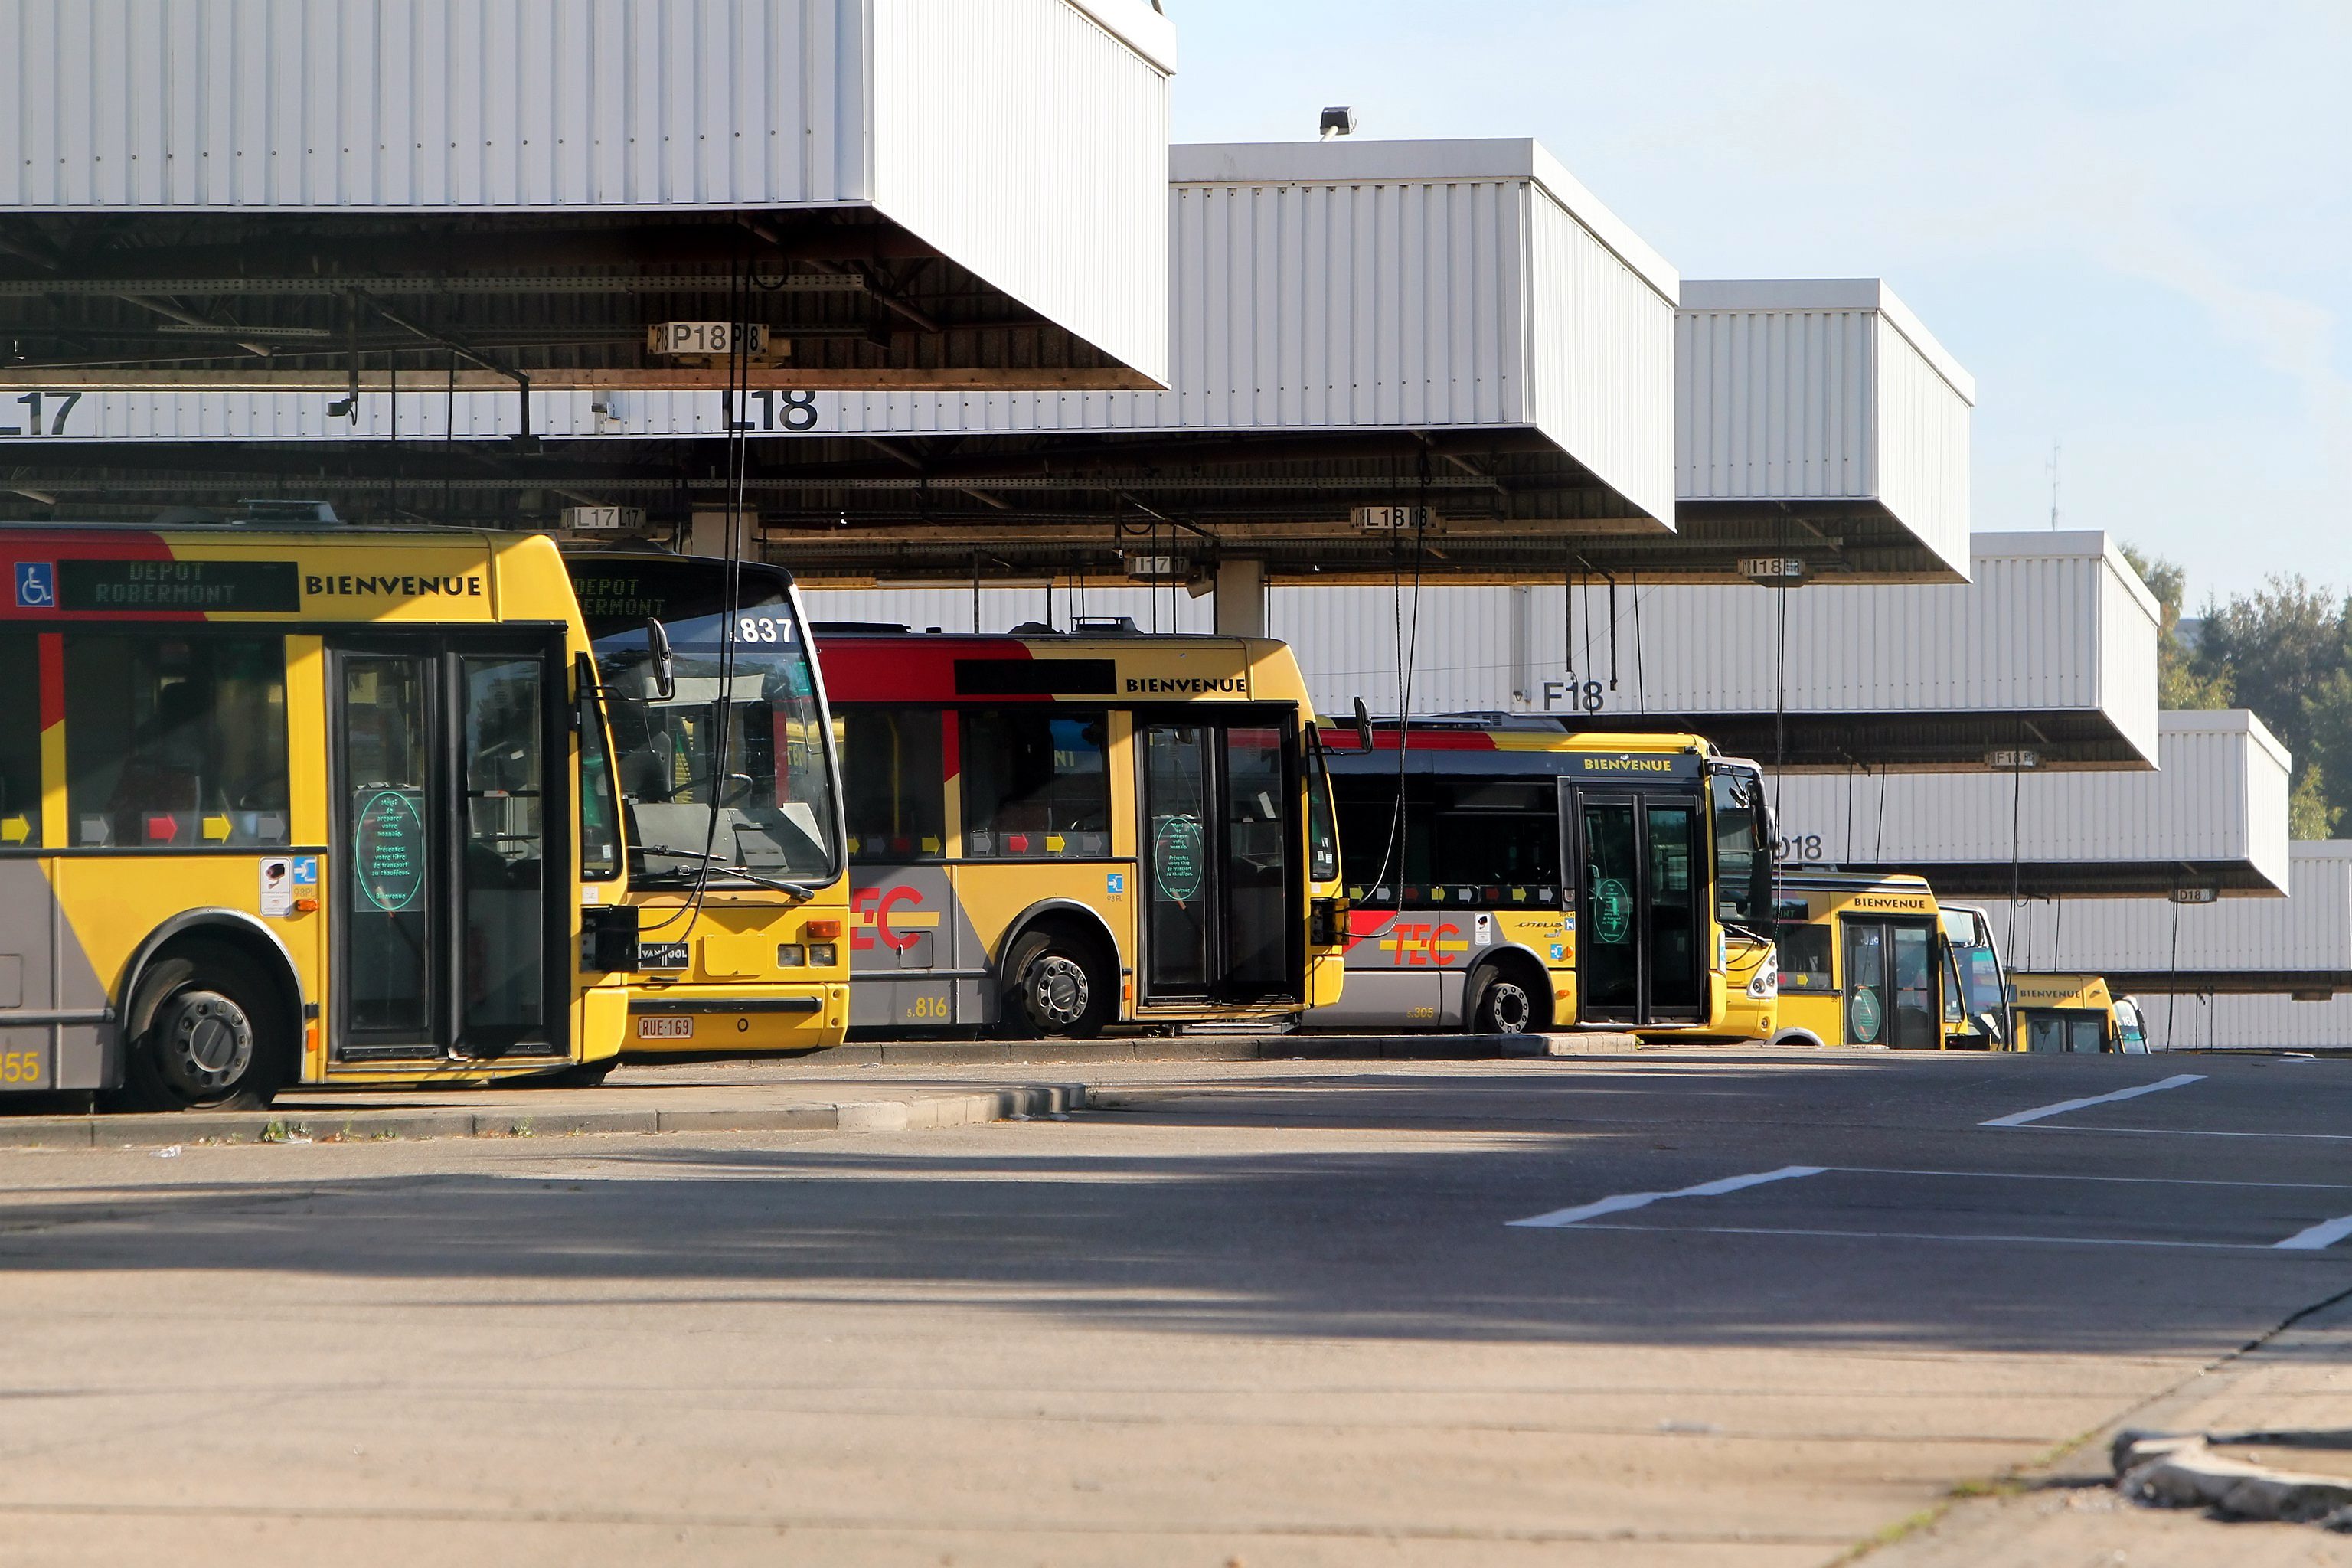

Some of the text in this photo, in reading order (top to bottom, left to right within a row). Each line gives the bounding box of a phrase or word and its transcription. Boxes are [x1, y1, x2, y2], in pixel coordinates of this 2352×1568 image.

[673, 324, 727, 351] P18
[734, 325, 759, 351] P8
[722, 390, 818, 431] L18
[577, 508, 615, 527] L17
[619, 508, 639, 527] L17
[1367, 508, 1405, 527] L18
[129, 562, 204, 580] DEPOT
[1753, 560, 1782, 574] I18
[95, 583, 236, 603] ROBERMONT
[305, 576, 481, 596] BIENVENUE
[573, 579, 639, 595] DEPOT
[1126, 678, 1246, 693] BIENVENUE
[1544, 681, 1604, 711] F18
[1583, 759, 1671, 772] BIENVENUE
[1997, 752, 2021, 764] F18
[1854, 897, 1926, 909] BIENVENUE
[2180, 890, 2201, 900] D18
[1392, 923, 1460, 965] TEC
[2020, 989, 2081, 998] BIENVENUE
[906, 997, 947, 1018] 5.816
[0, 1052, 41, 1083] 55
